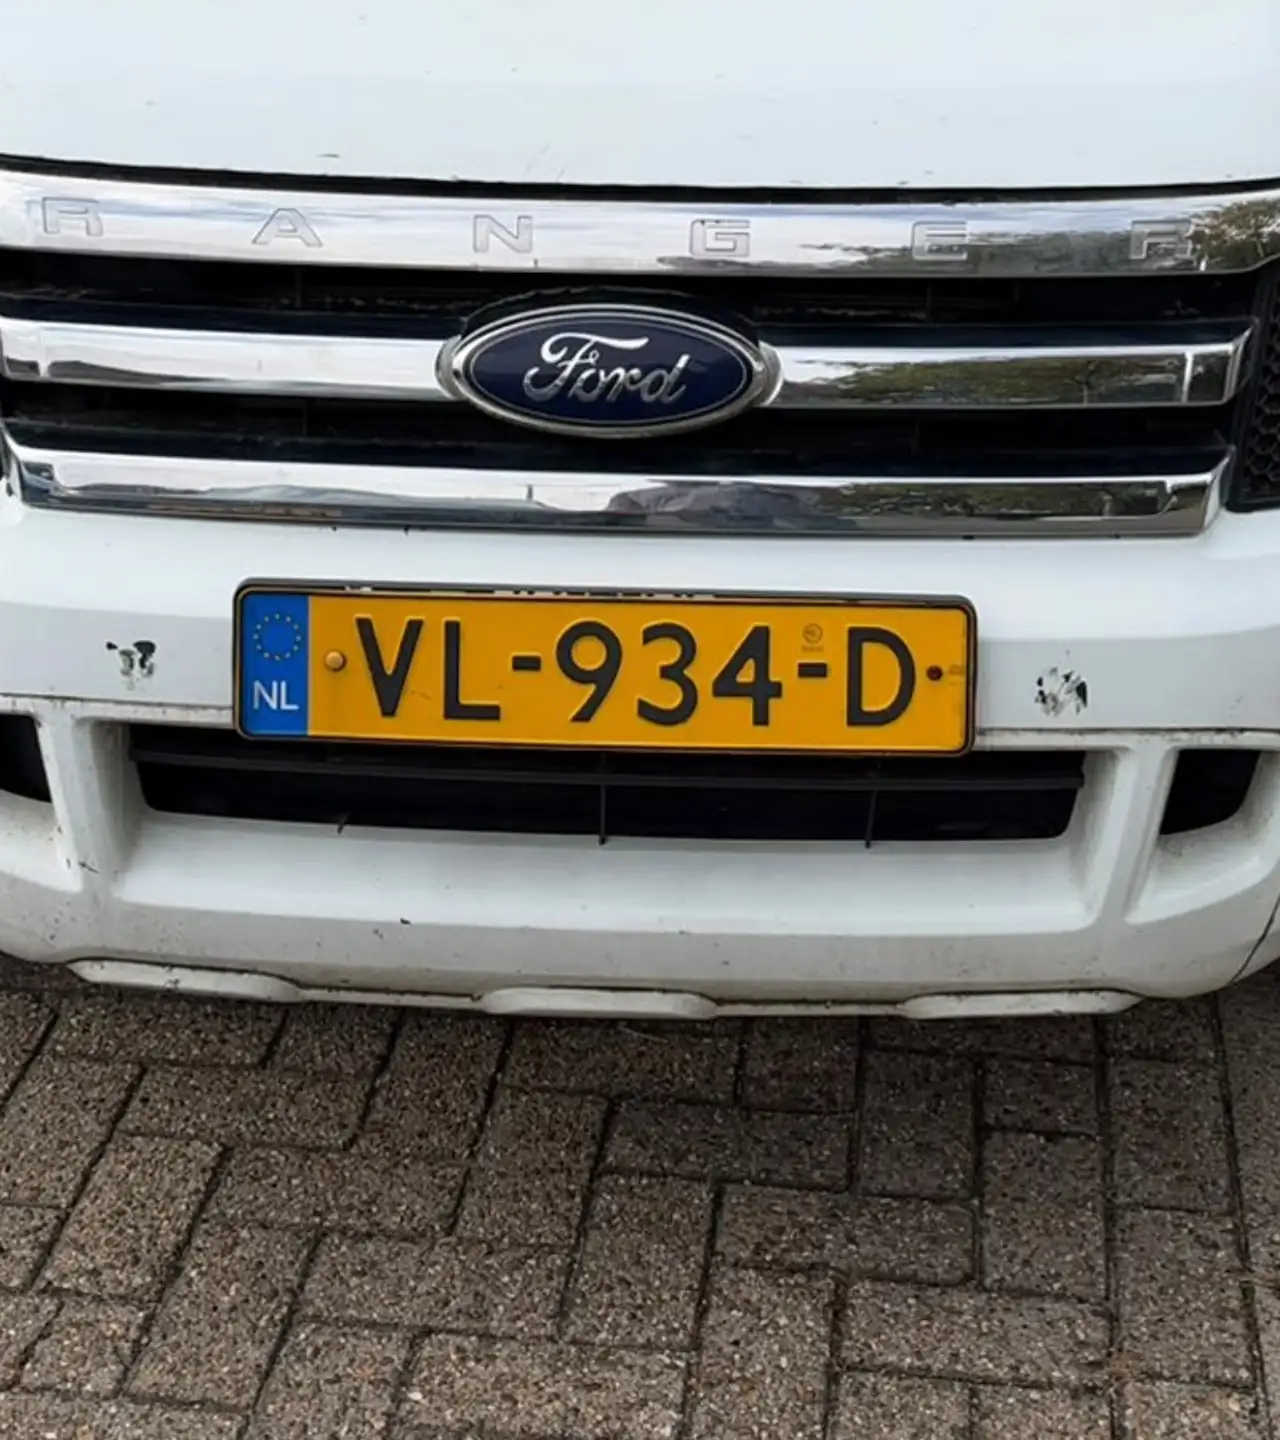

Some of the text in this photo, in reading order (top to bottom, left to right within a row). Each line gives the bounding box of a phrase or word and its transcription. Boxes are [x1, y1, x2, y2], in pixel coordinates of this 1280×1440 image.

[40, 194, 1196, 261] RANGER
[522, 331, 691, 404] Ford
[252, 615, 917, 728] NL VL-934-D
